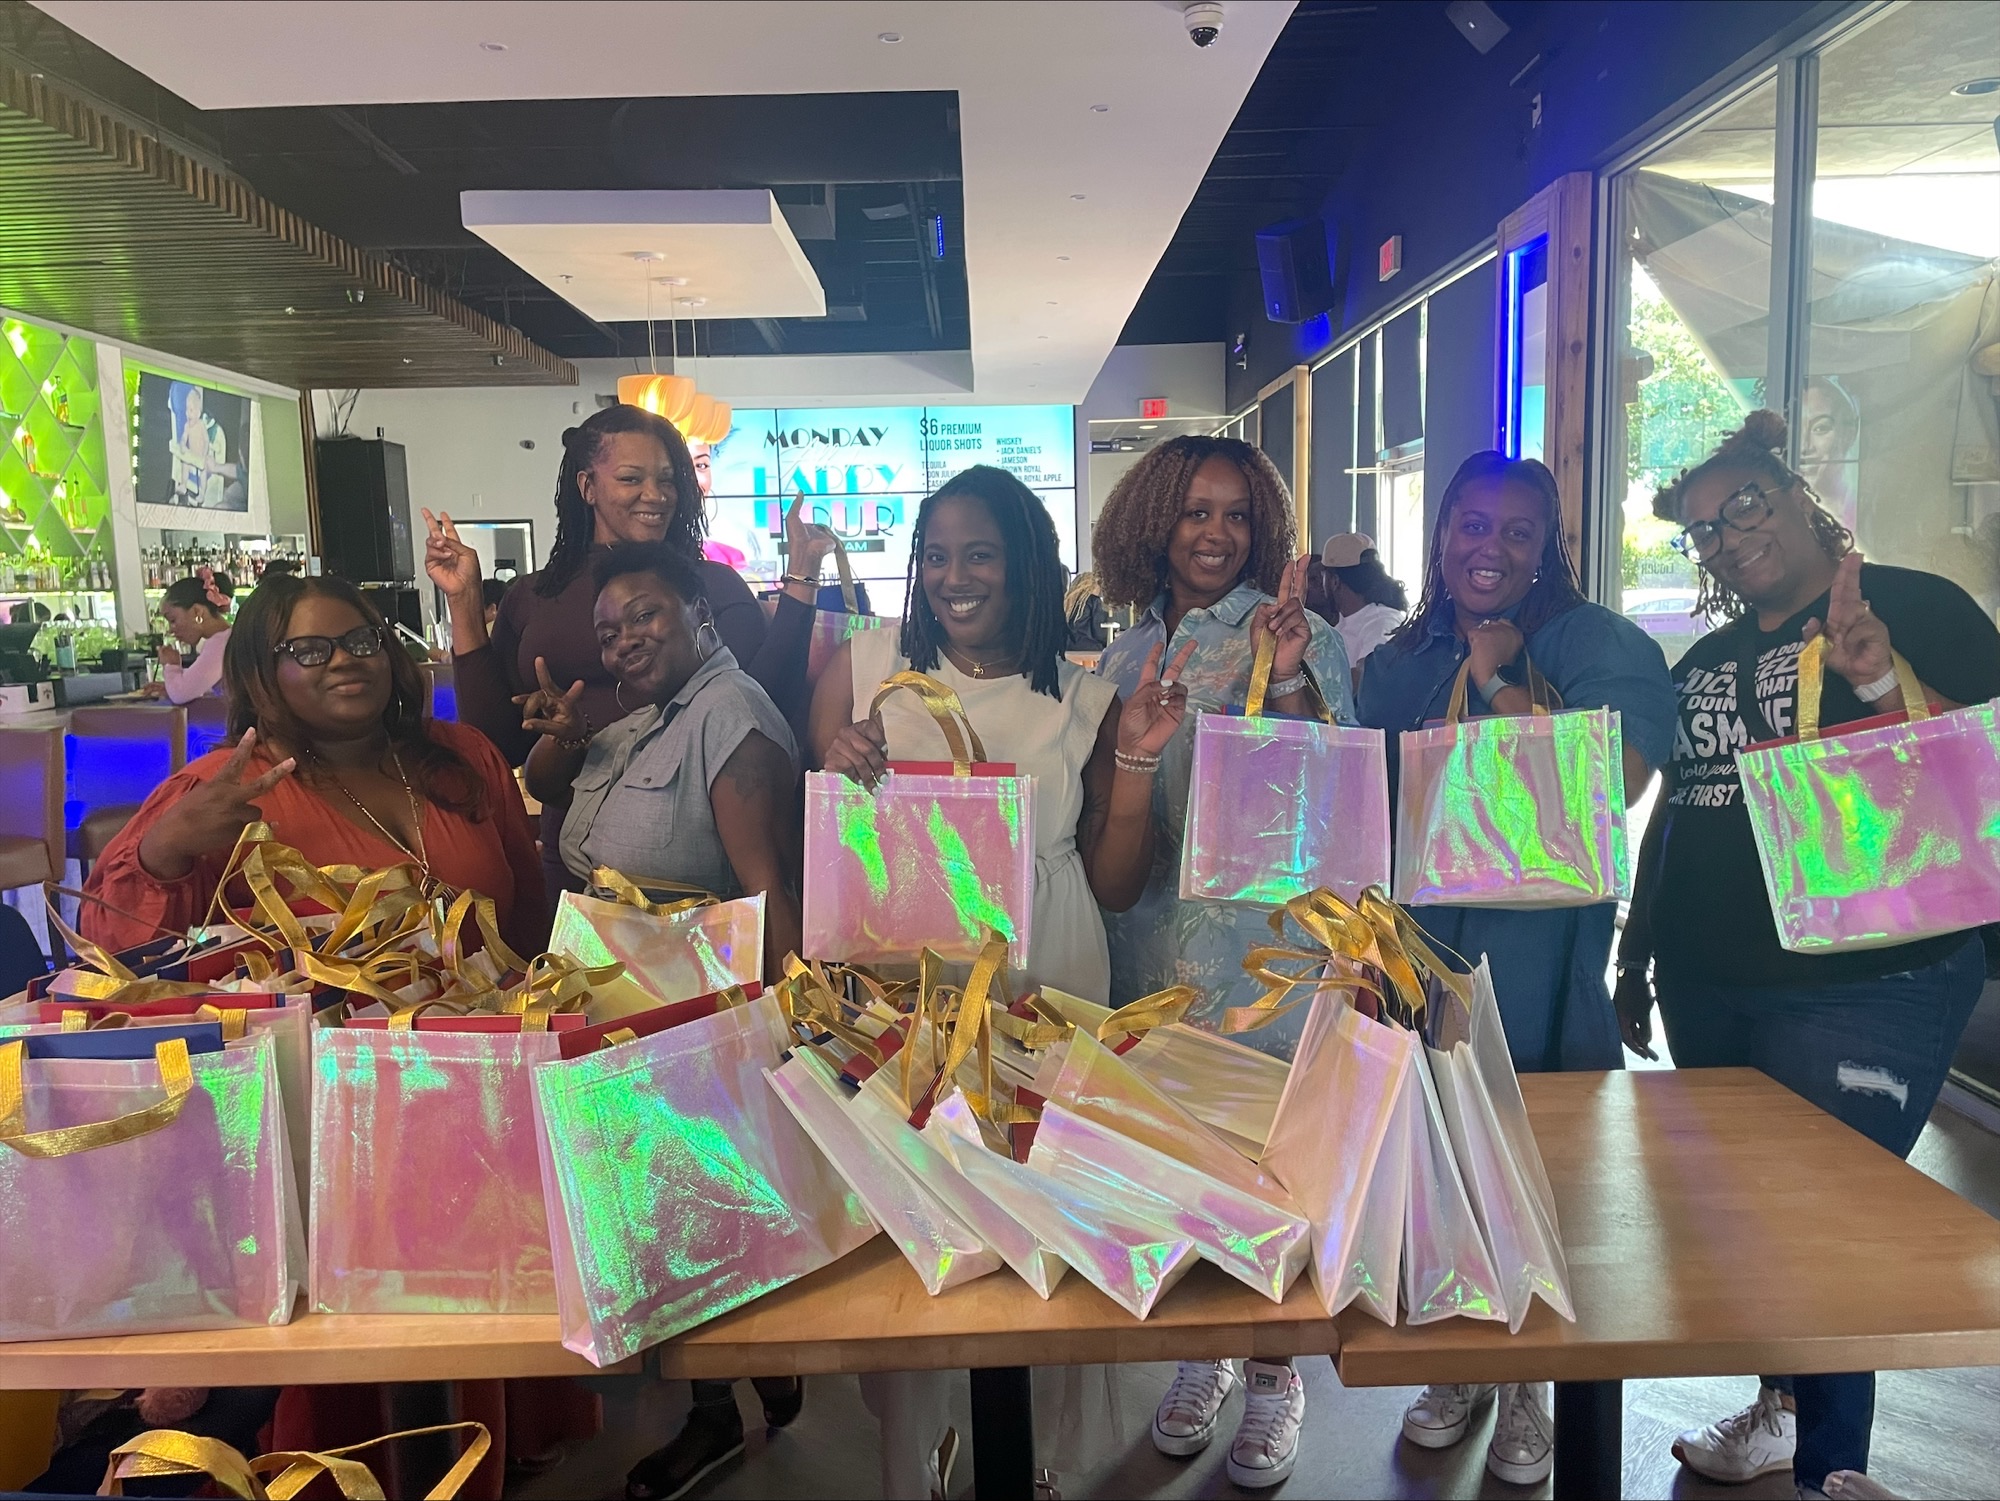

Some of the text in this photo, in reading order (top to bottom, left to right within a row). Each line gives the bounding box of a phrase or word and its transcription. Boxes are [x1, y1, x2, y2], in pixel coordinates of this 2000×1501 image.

[920, 418, 982, 436] $6 PREMIUM
[764, 427, 889, 449] MONDAY
[920, 439, 982, 451] LIQUOR SHOTS
[996, 438, 1022, 446] WHISKEY
[1016, 446, 1042, 454] DANIEL'S
[1001, 456, 1028, 464] JAMESON
[753, 463, 904, 495] HAPPY
[1043, 474, 1062, 482] APPLE
[1680, 763, 1707, 780] told
[1686, 783, 1740, 807] FIRST
